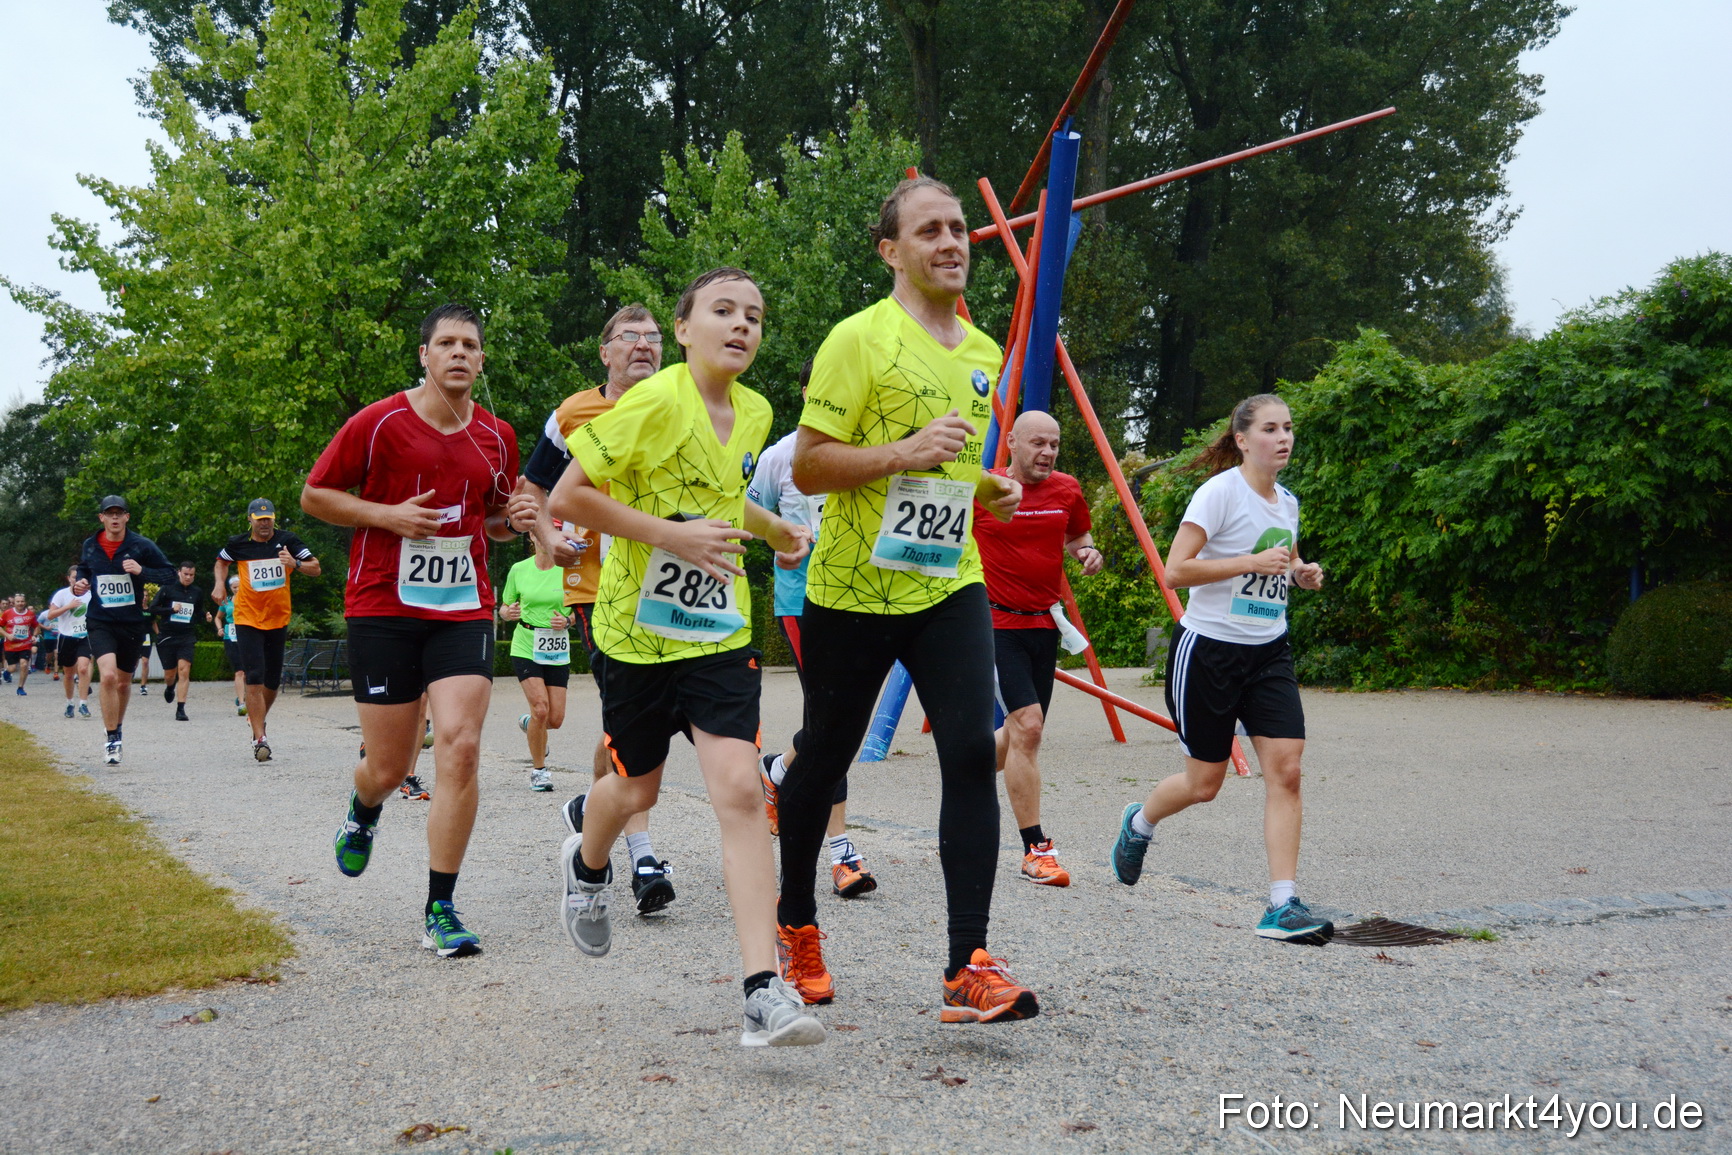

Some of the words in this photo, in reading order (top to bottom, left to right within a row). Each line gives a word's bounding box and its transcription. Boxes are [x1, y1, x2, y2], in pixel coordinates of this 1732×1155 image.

[583, 422, 601, 447] Team
[598, 445, 616, 467] Partl
[892, 500, 967, 543] 2824
[901, 545, 943, 564] Thomas
[253, 565, 283, 580] 2810
[408, 554, 472, 584] 2012
[100, 582, 131, 595] 2900
[653, 562, 728, 610] 2823
[1241, 572, 1287, 601] 2136
[670, 609, 717, 629] Moritz
[1247, 603, 1279, 618] Ramona
[538, 637, 567, 651] 2356
